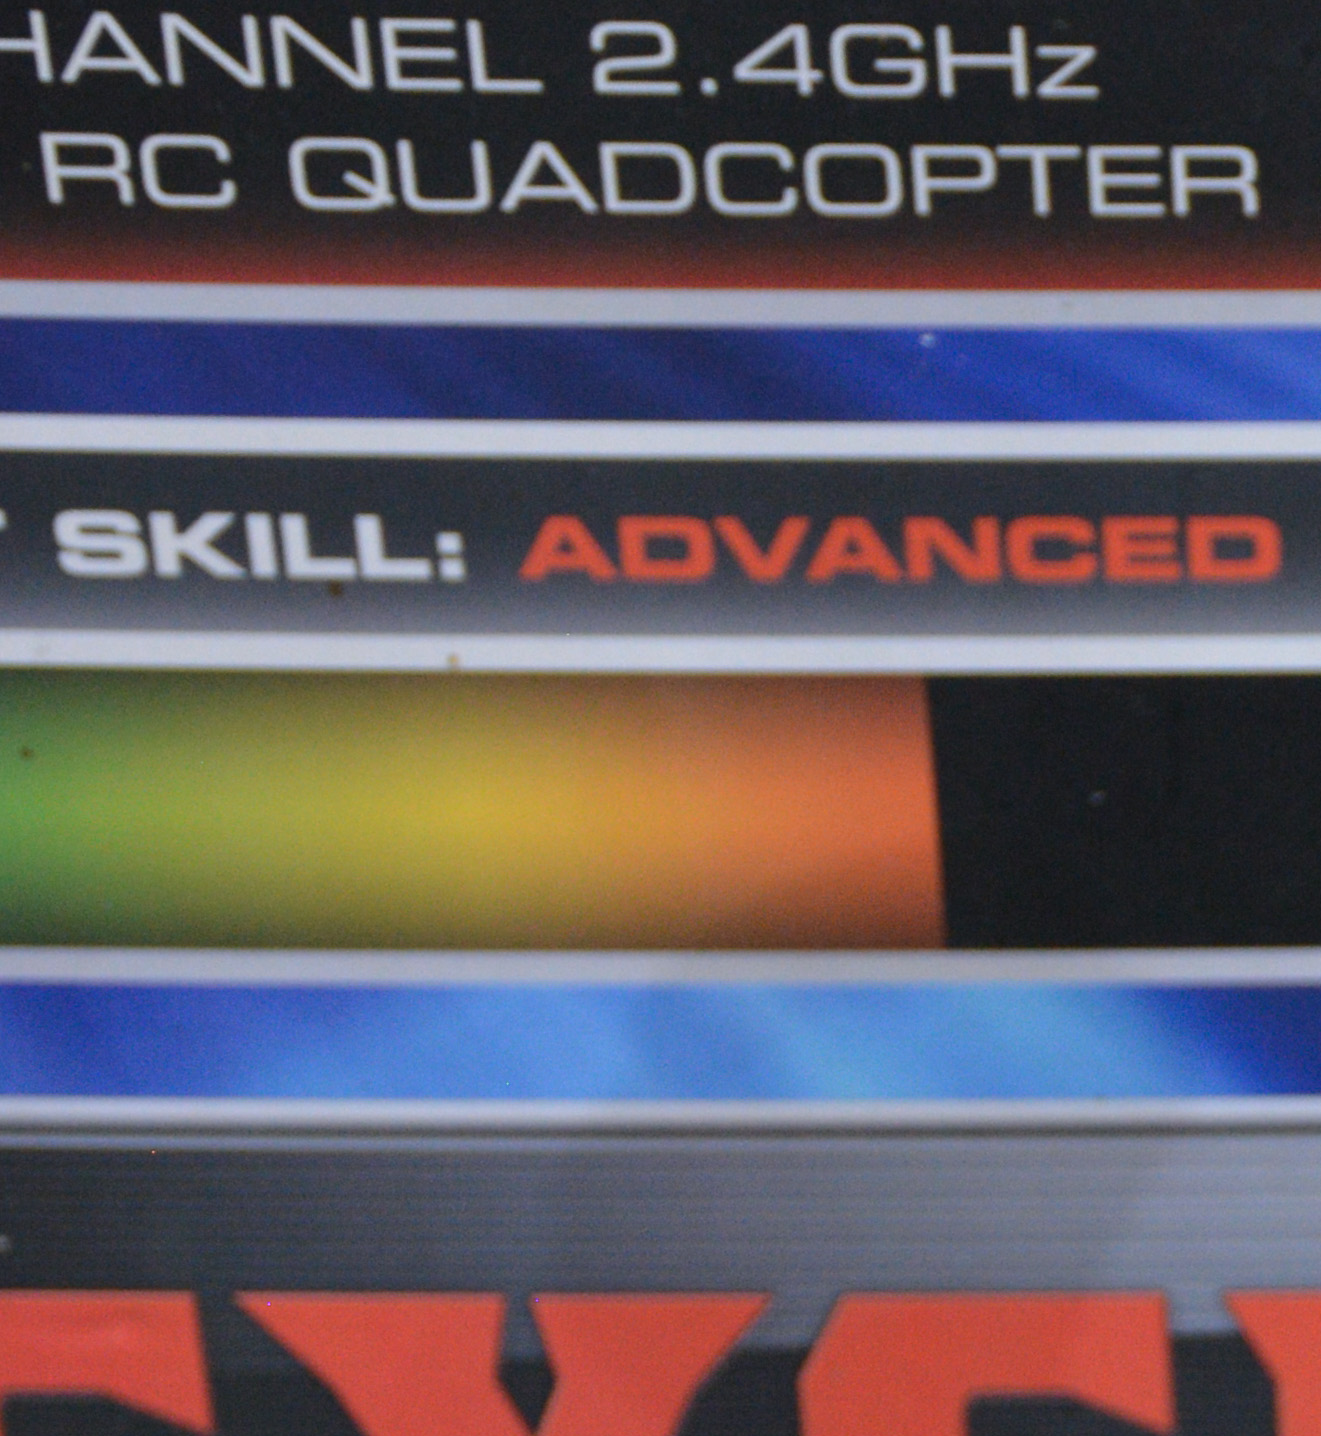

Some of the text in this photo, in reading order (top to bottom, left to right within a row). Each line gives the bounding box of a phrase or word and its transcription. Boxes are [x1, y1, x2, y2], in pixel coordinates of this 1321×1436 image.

[588, 20, 1100, 98] 2.4GHz
[39, 131, 1260, 217] RC QUADCOPTER
[53, 508, 466, 581] SKILL:
[519, 514, 1283, 583] ADVANCED
